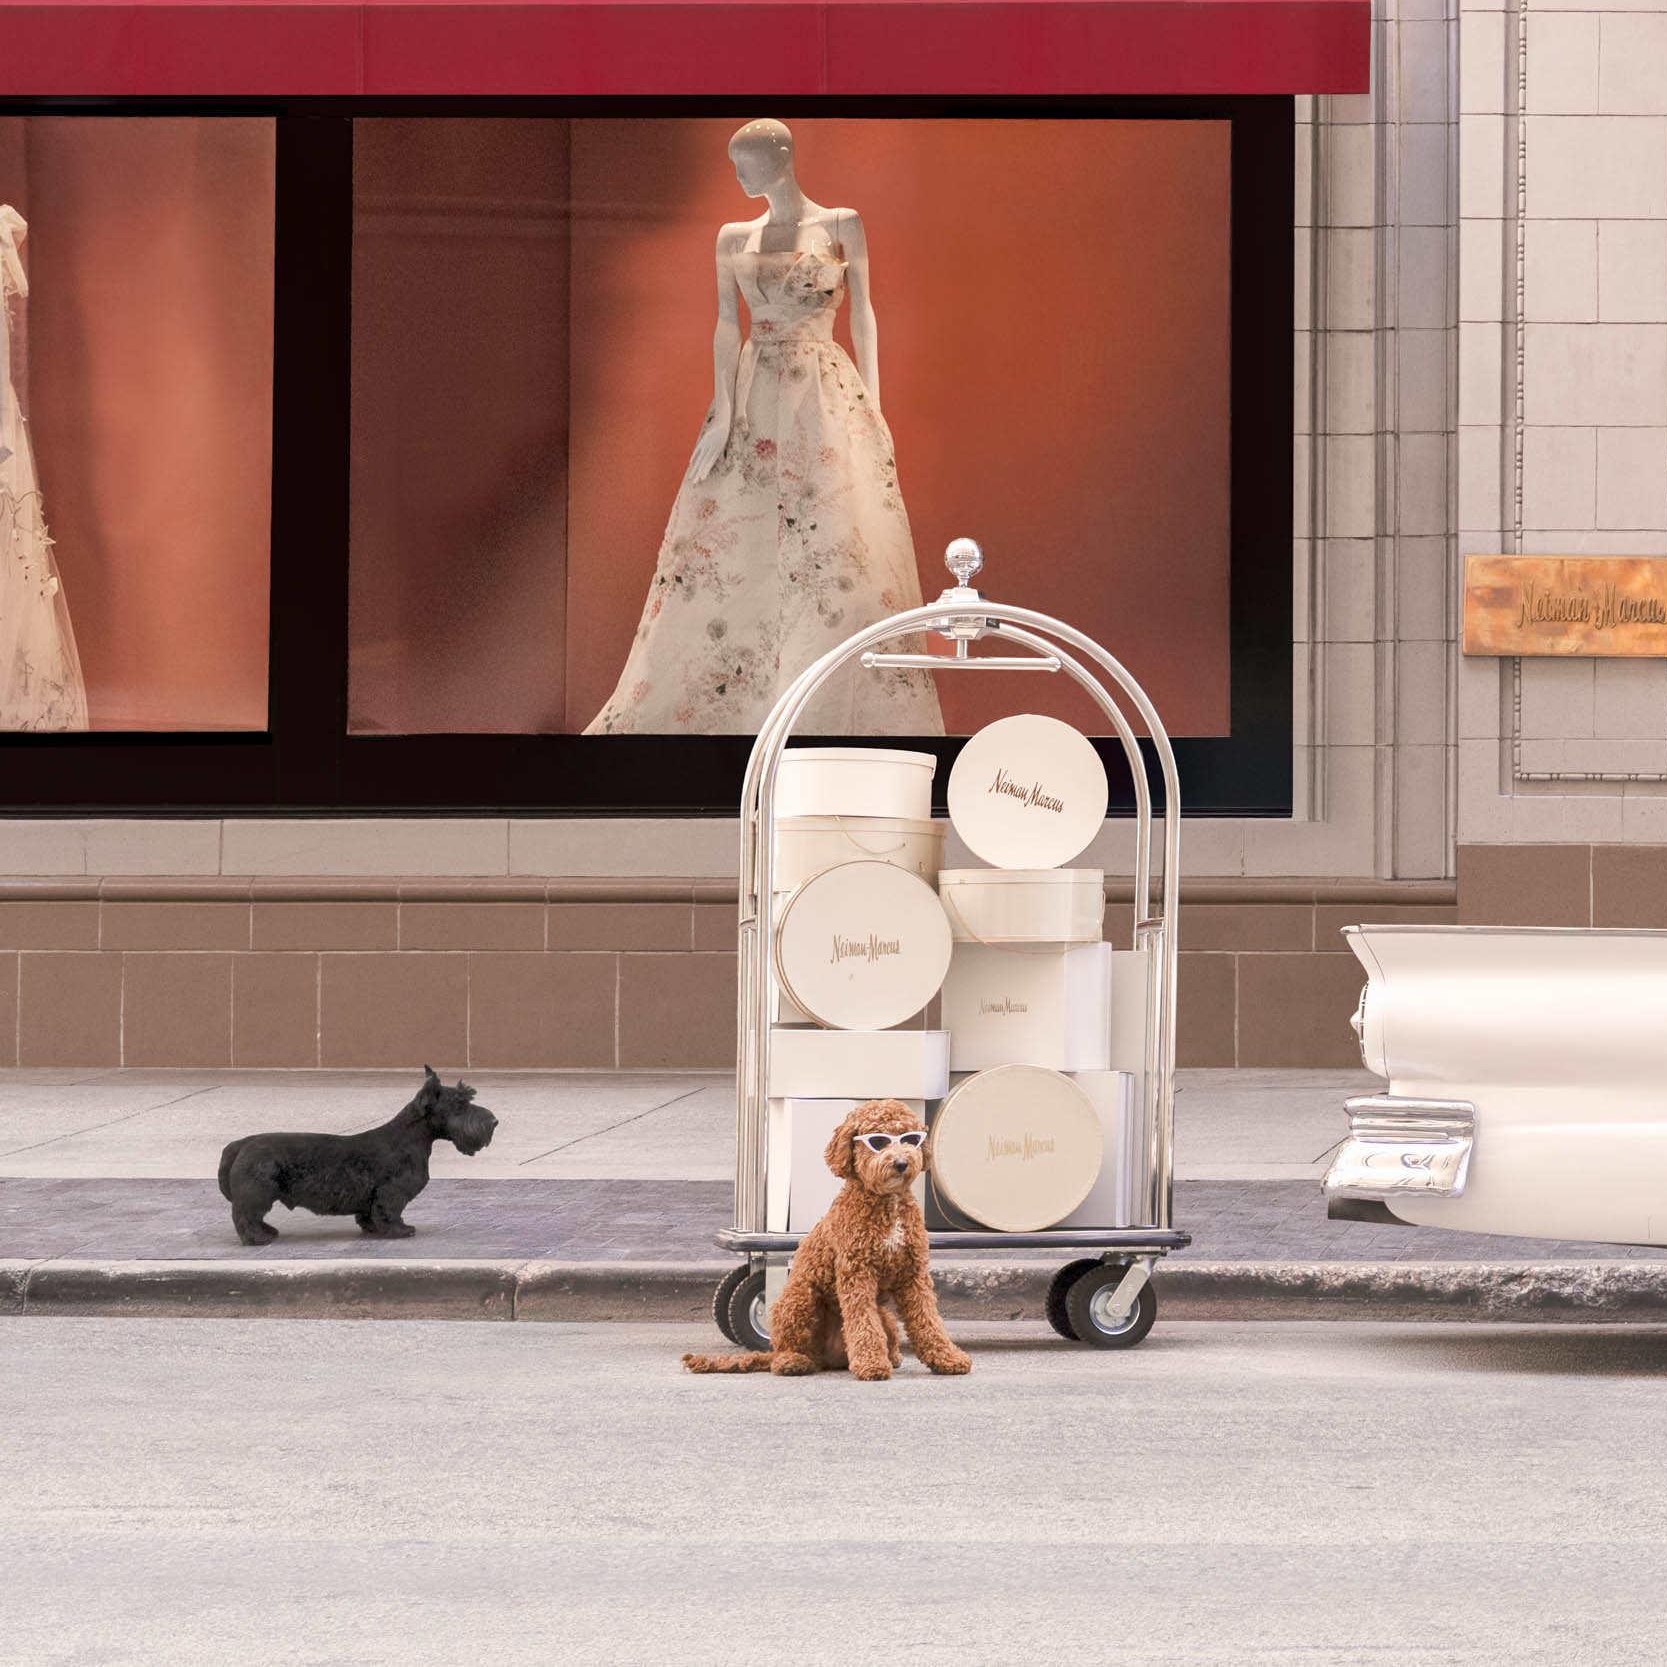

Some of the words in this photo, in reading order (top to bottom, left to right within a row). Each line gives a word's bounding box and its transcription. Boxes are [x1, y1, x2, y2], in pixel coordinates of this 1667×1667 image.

[1516, 581, 1590, 629] Neiman
[1594, 581, 1667, 630] Marcus
[988, 768, 1028, 801] Neiman
[1024, 781, 1064, 813] Marcus
